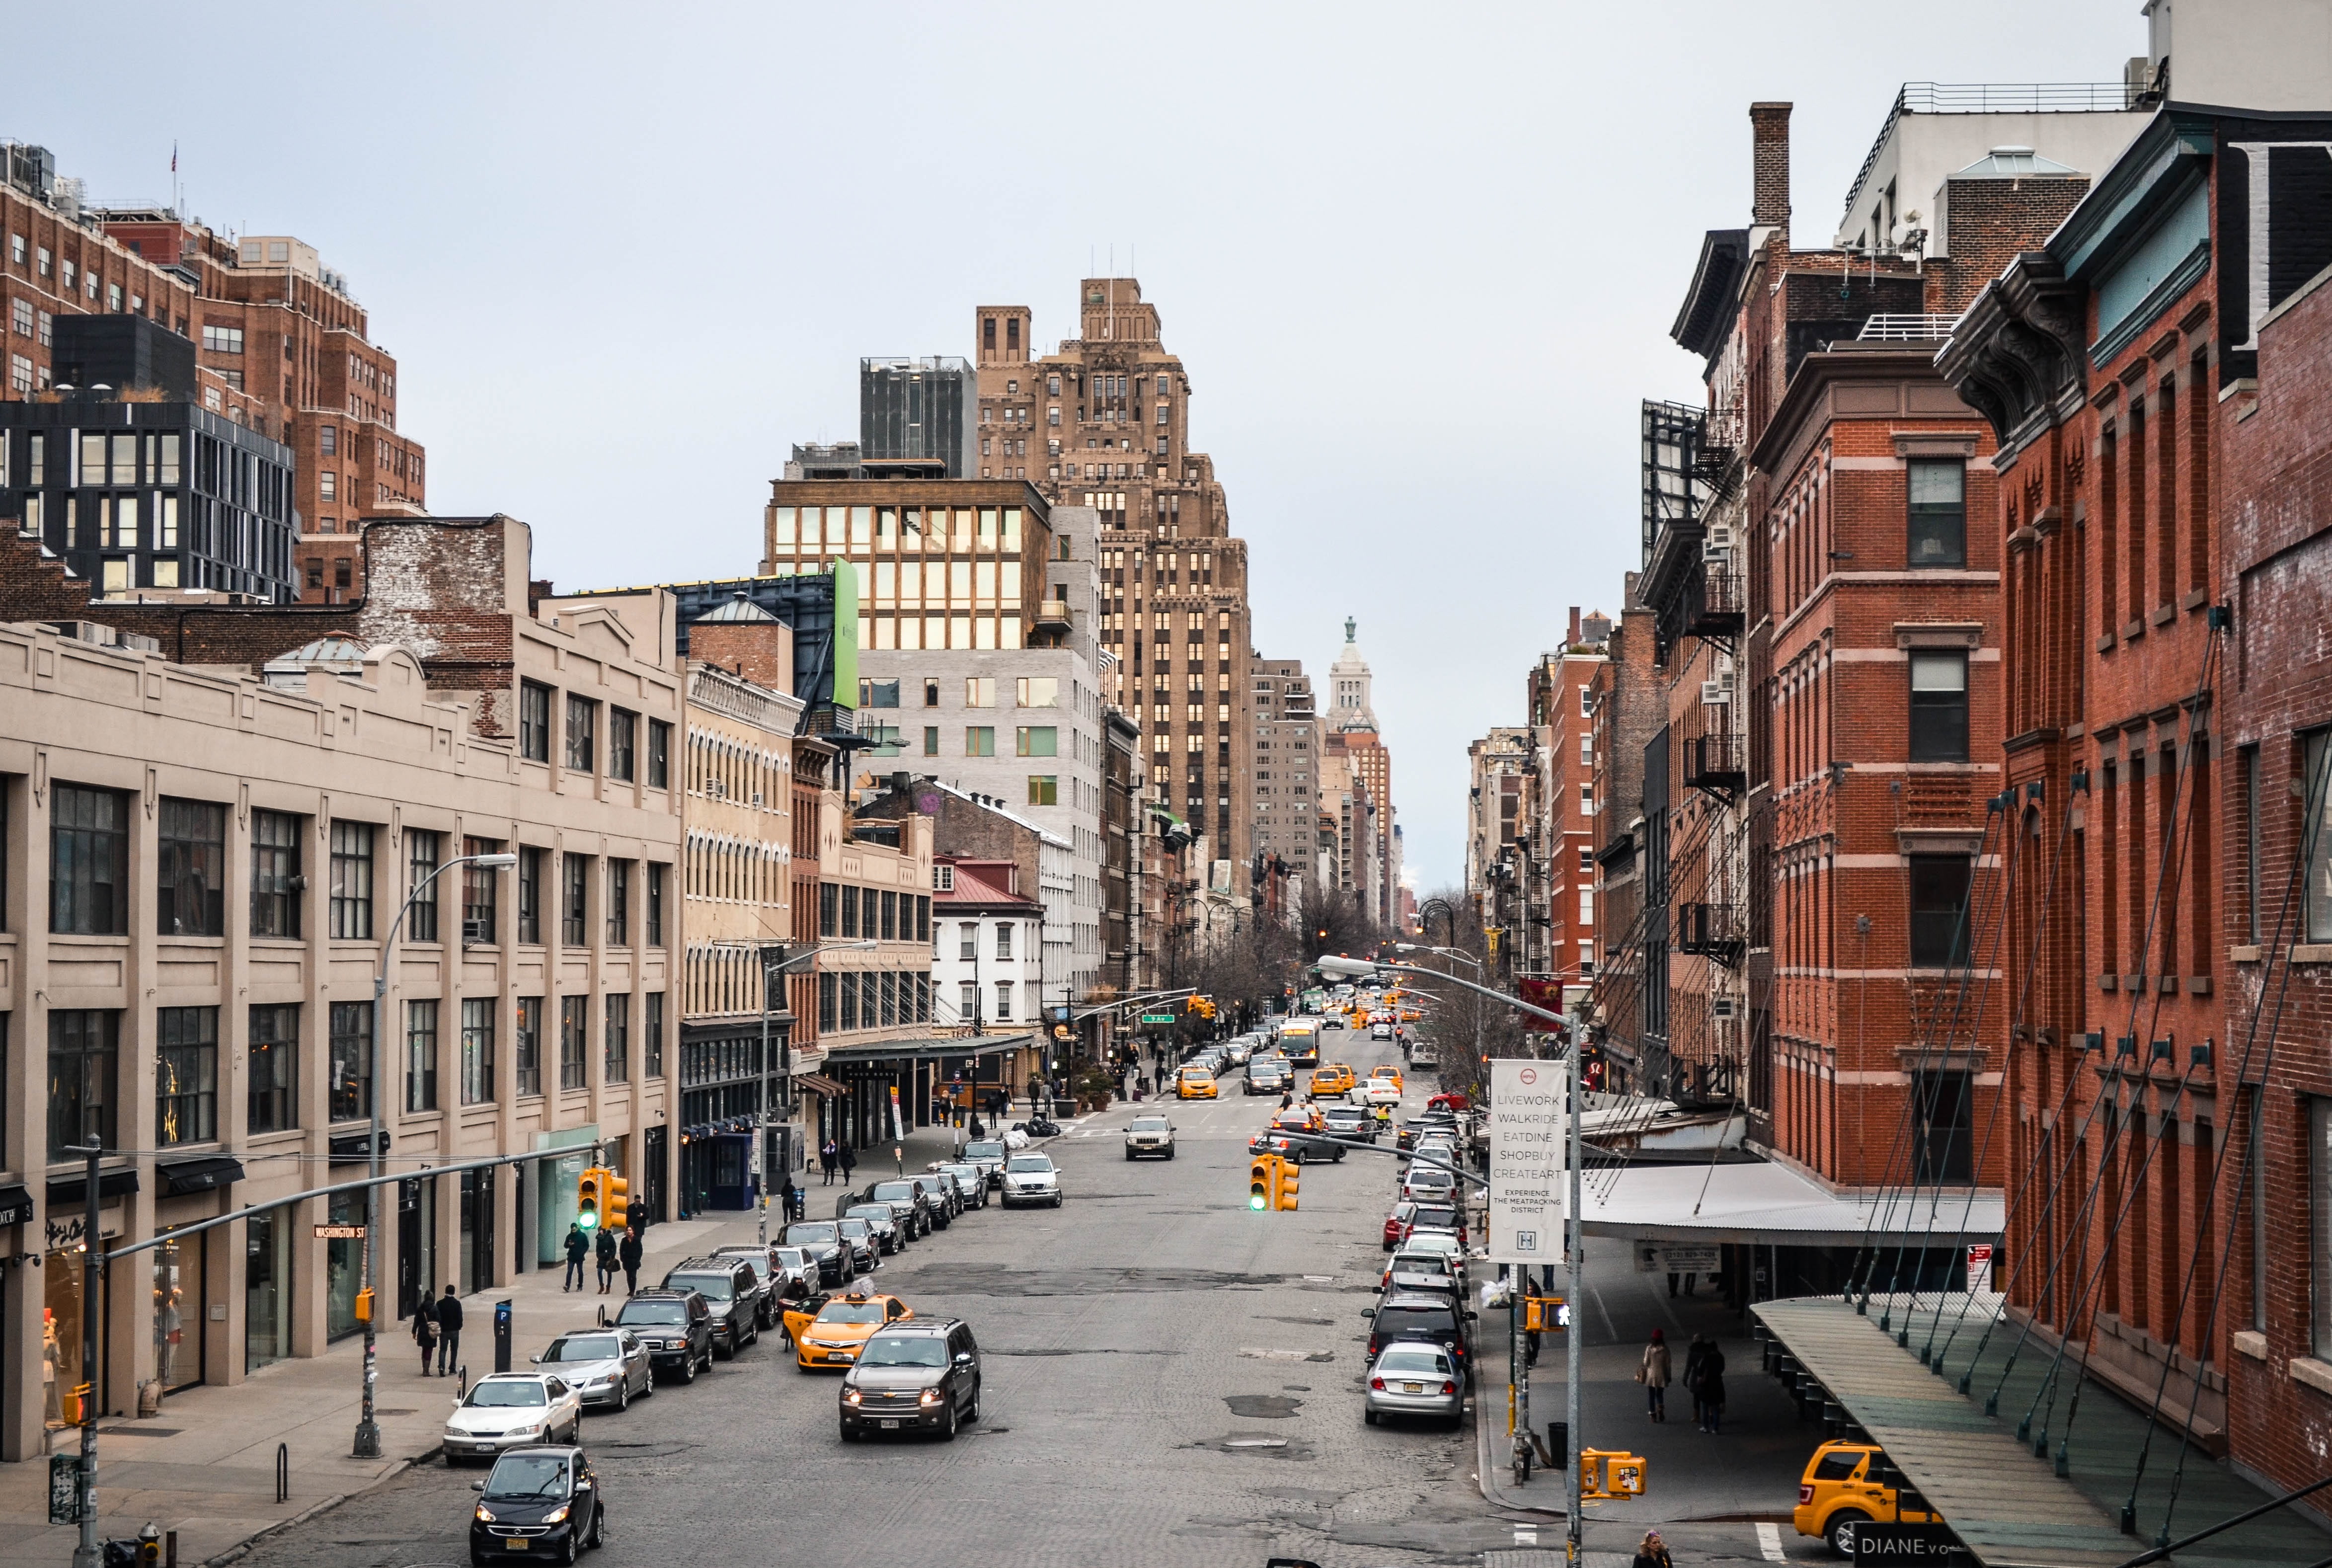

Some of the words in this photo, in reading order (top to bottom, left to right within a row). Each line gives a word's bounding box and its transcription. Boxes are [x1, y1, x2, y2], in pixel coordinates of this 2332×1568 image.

[1498, 1095, 1559, 1105] LIVEWORK
[1498, 1114, 1558, 1124] WALKRIDE
[1503, 1133, 1553, 1143] EATDINE
[1500, 1150, 1555, 1161] SHOPBUY
[1493, 1169, 1561, 1179] CREATEART
[315, 1227, 355, 1238] WASHINGTON
[357, 1227, 365, 1238] ST
[501, 1312, 507, 1320] P
[1862, 1538, 1925, 1554] DIANE
